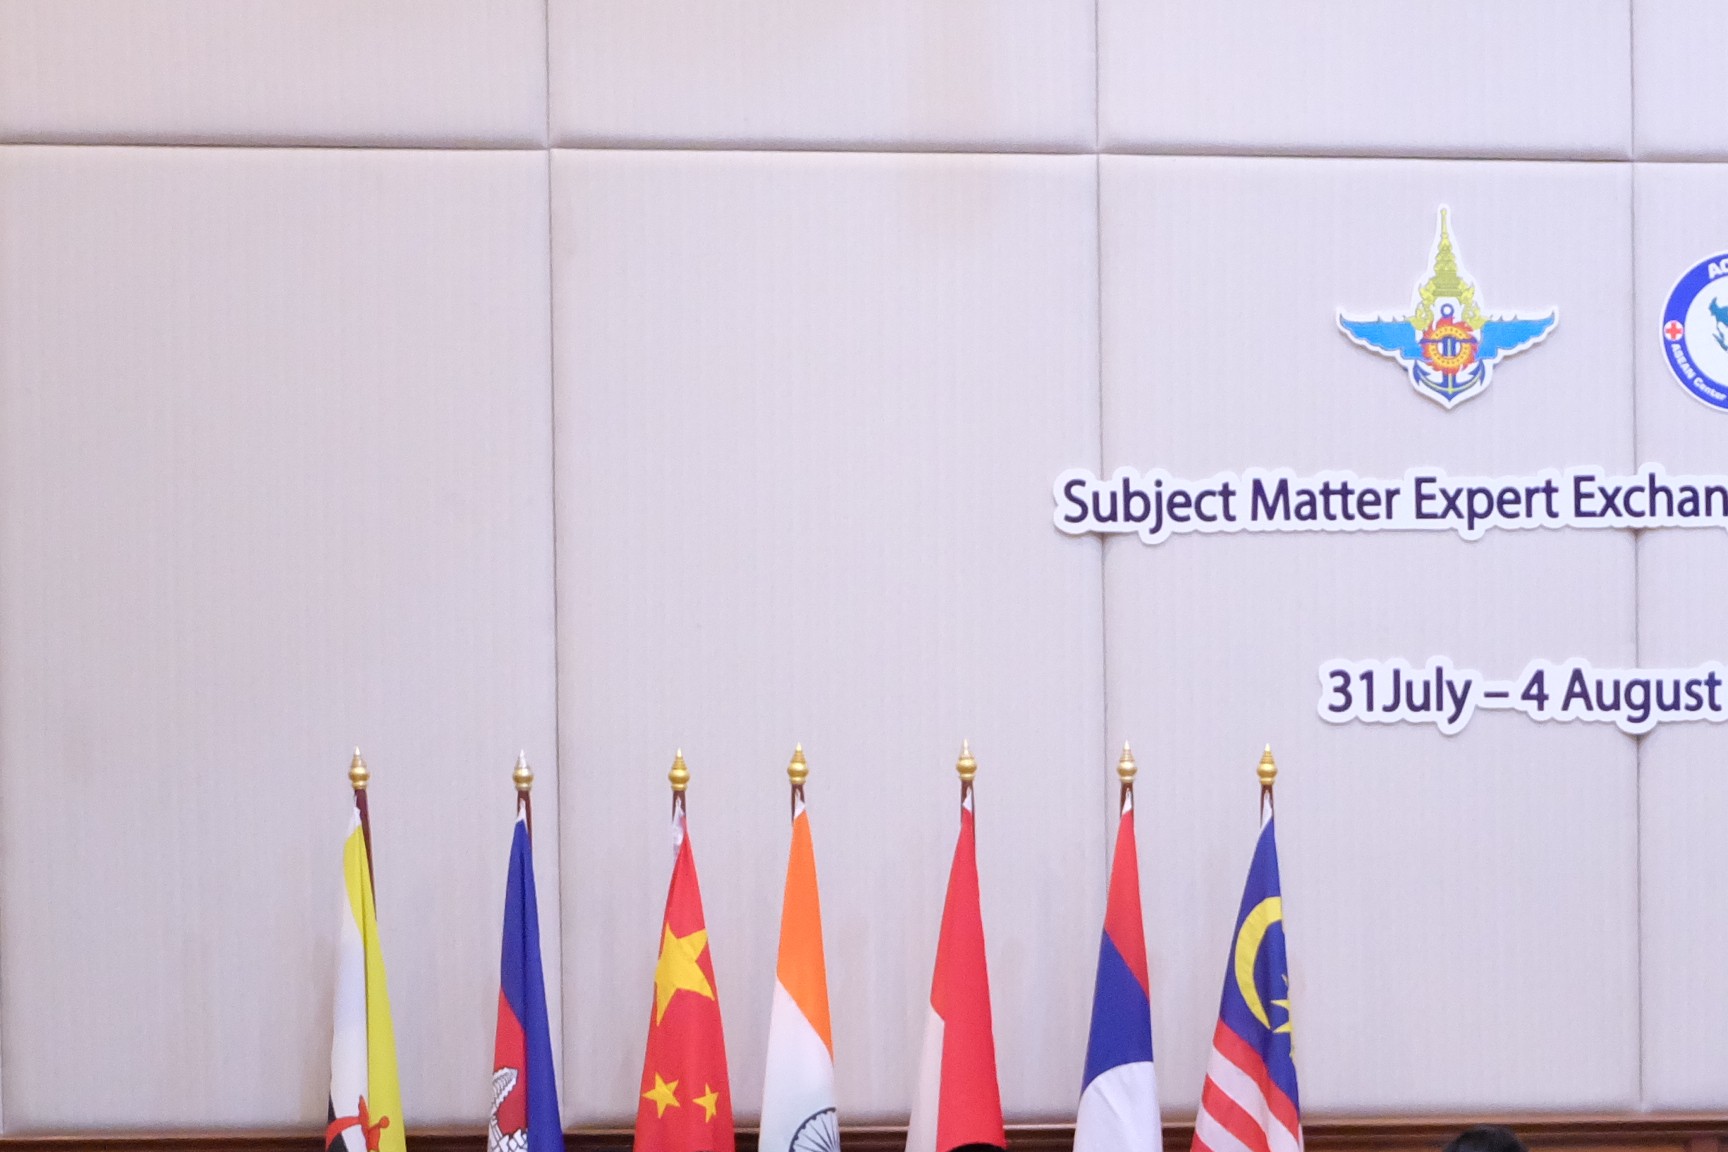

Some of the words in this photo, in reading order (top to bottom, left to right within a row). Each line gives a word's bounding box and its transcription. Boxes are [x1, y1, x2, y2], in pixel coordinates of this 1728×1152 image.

[1670, 343, 1696, 381] ASEAN
[1693, 375, 1727, 402] Center
[1064, 478, 1236, 533] Subject
[1251, 478, 1401, 521] Matter
[1415, 477, 1559, 531] Expert
[1521, 670, 1549, 711] 4
[1561, 668, 1722, 724] August
